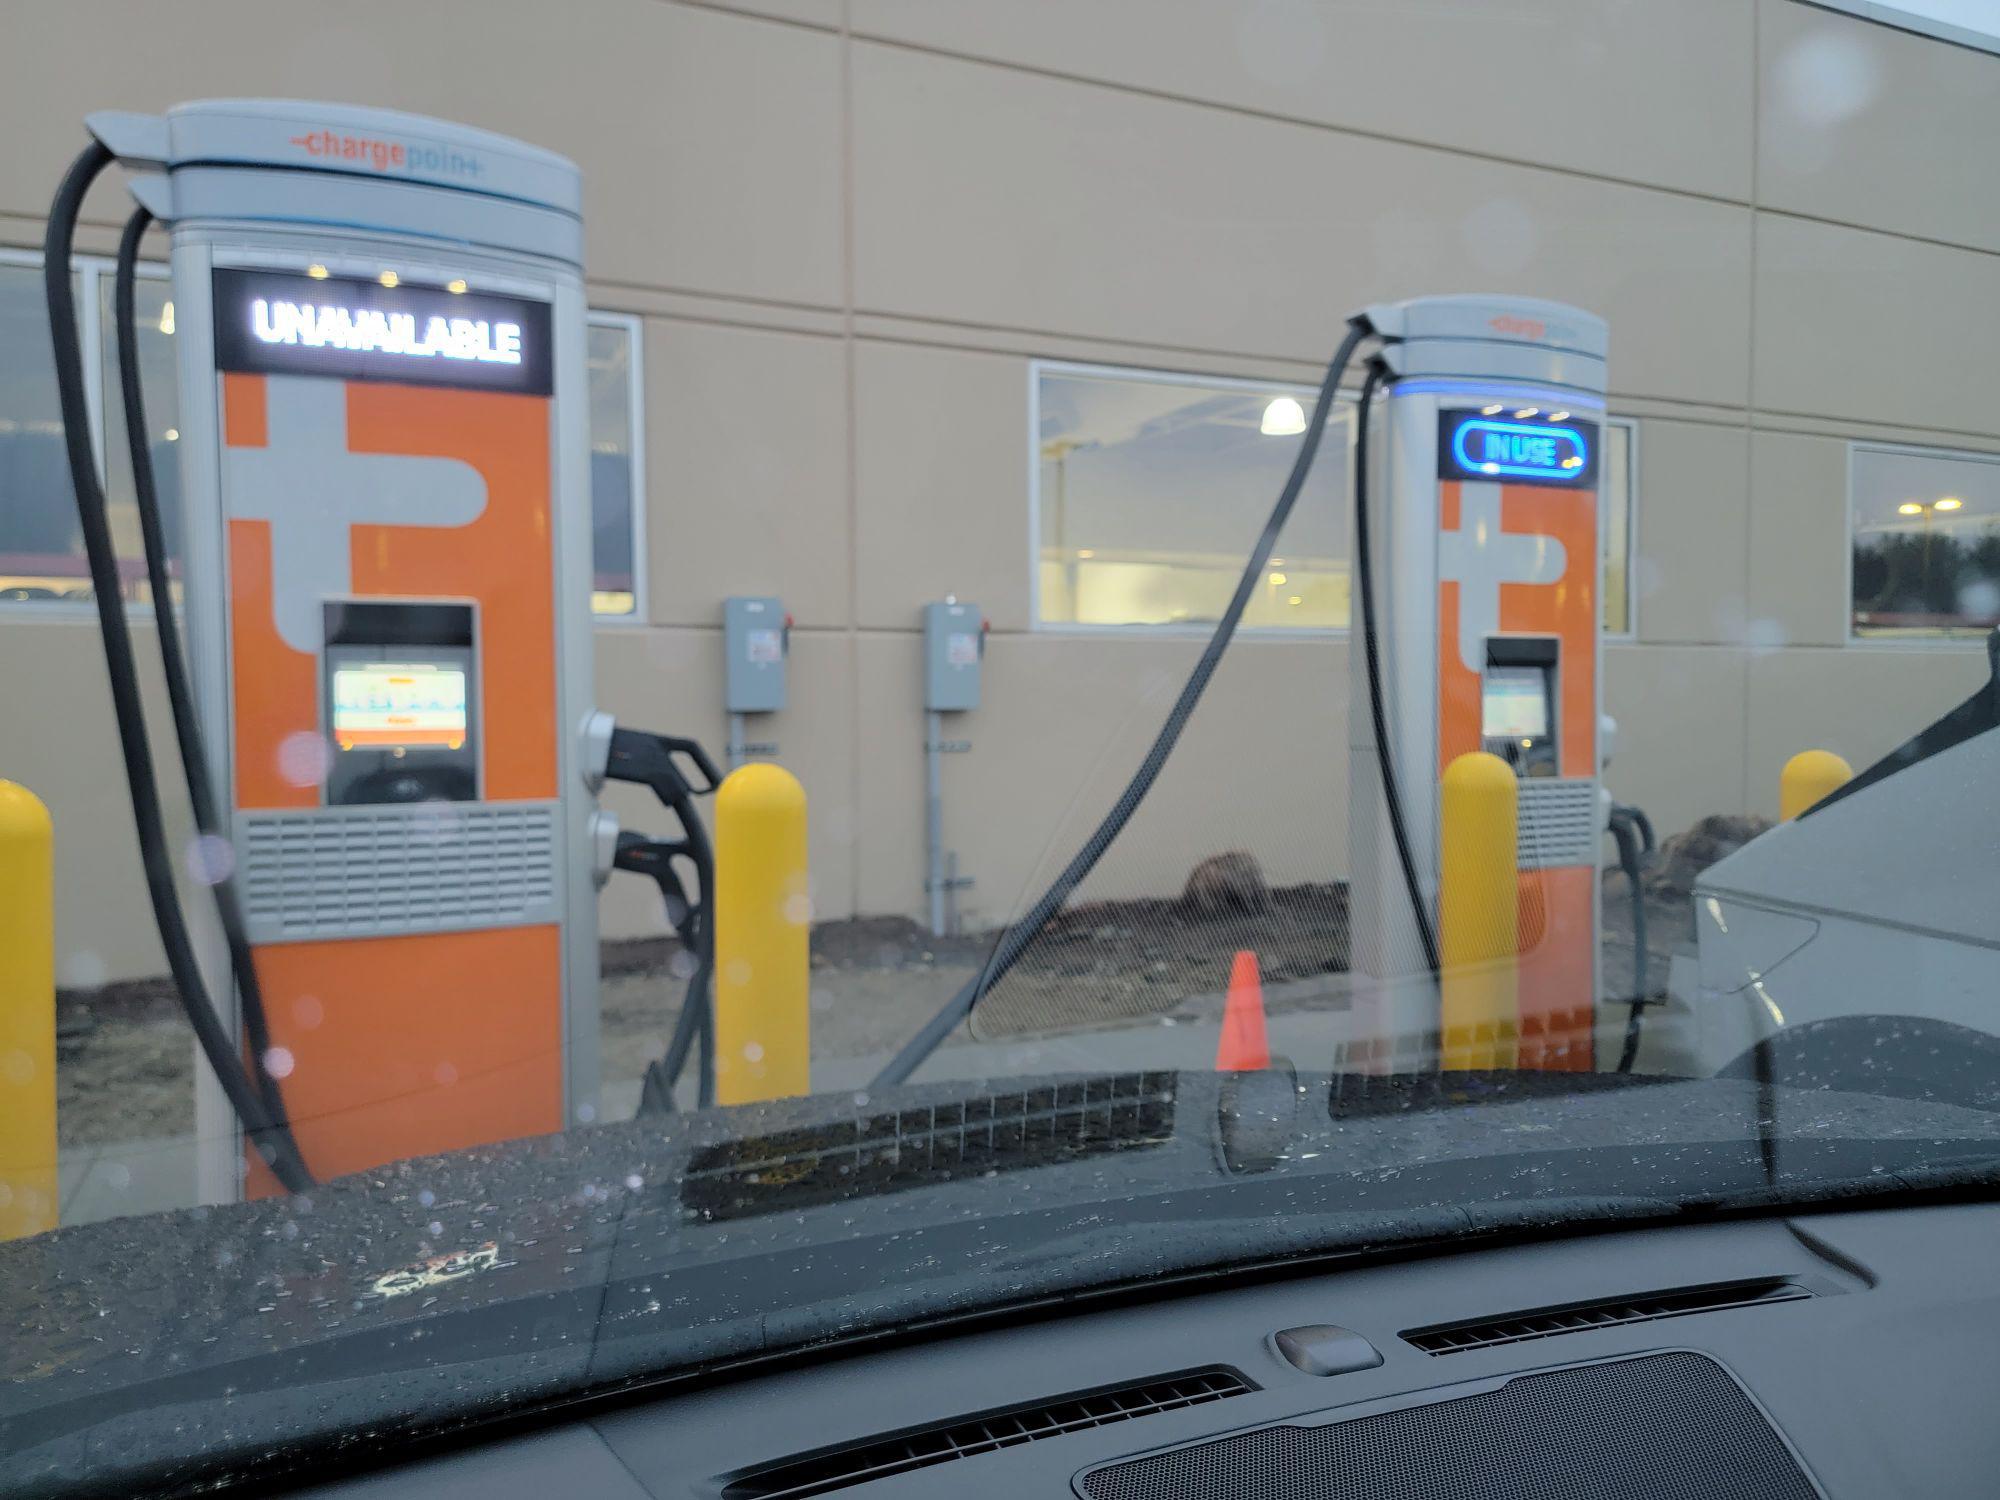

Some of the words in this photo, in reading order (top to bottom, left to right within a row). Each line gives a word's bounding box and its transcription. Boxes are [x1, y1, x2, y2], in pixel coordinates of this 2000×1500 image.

[252, 299, 522, 364] UNAVAILABLE
[1483, 433, 1511, 463] IN
[1512, 436, 1557, 467] USE
